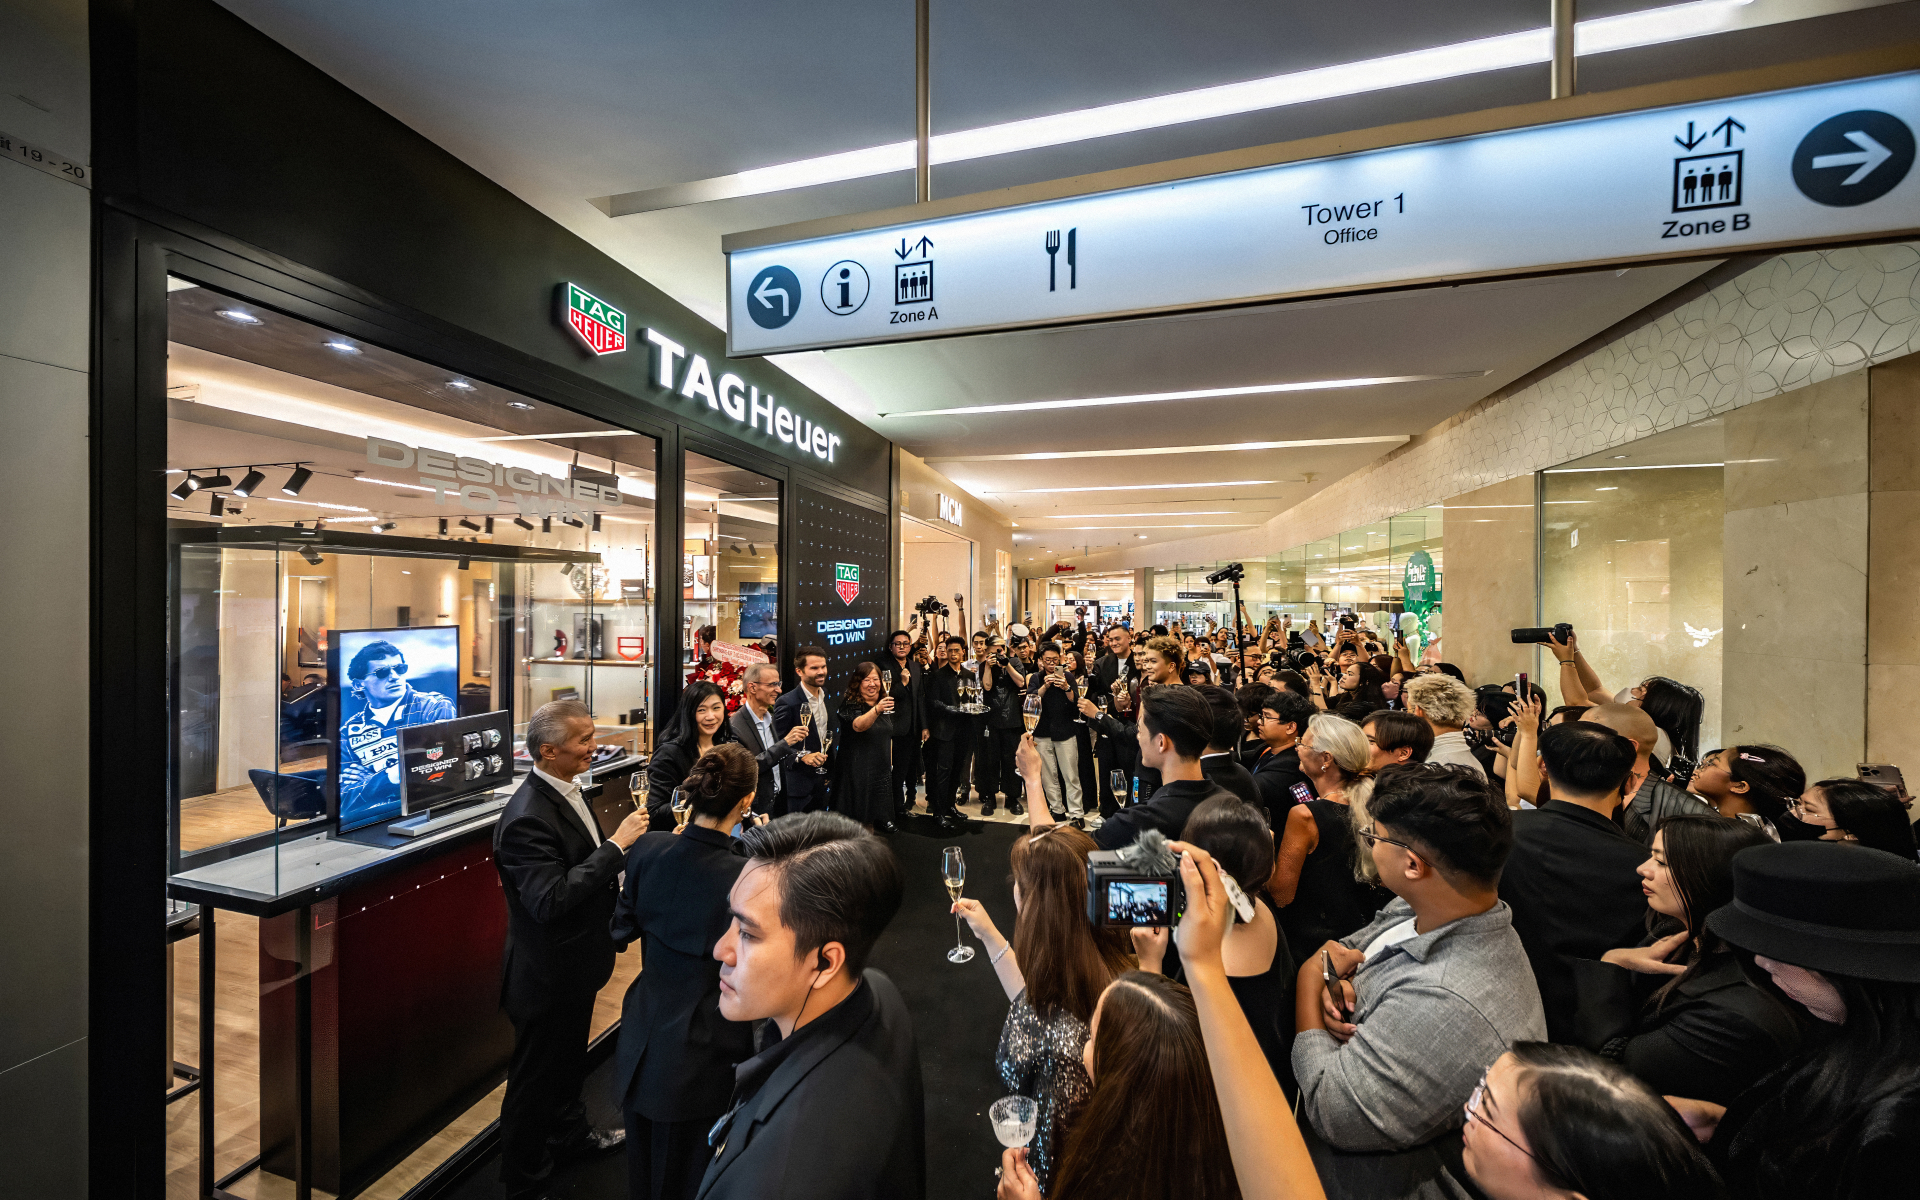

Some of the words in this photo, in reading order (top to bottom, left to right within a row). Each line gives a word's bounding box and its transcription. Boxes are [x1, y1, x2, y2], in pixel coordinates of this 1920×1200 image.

[20, 146, 42, 162] 19
[62, 162, 85, 179] 20
[1301, 200, 1383, 226] Tower
[1393, 192, 1404, 214] 1
[1324, 227, 1378, 245] Office
[1661, 220, 1726, 239] Zone
[1732, 213, 1751, 231] B
[573, 289, 621, 331] TAG
[889, 310, 926, 324] Zone
[927, 306, 939, 320] A
[573, 311, 623, 351] HEUER
[366, 435, 624, 507] DESIGNED
[419, 476, 499, 512] TO
[511, 492, 595, 525] WIN
[939, 493, 962, 527] MCM
[837, 566, 858, 580] TAG
[837, 581, 858, 602] HEUER
[817, 618, 873, 633] DESIGNED
[827, 633, 844, 646] TO
[845, 630, 866, 643] WIN
[351, 730, 380, 745] BOSS
[411, 757, 459, 773] DESIGNED
[420, 767, 433, 775] TO
[434, 763, 453, 772] WIN
